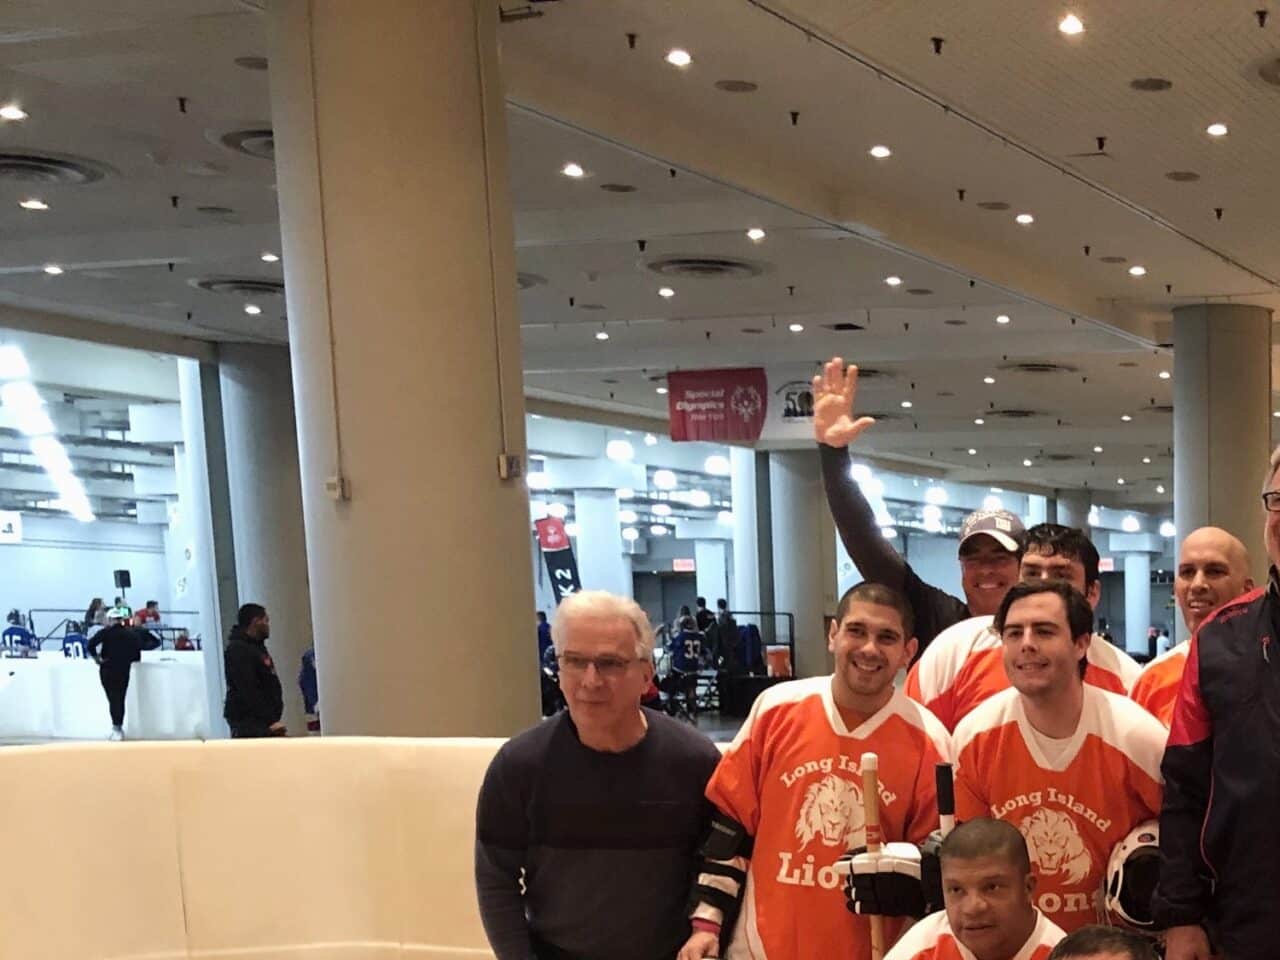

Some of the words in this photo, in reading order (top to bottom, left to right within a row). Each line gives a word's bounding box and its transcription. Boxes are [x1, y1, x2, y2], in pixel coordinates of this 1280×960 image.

[554, 567, 572, 581] 2
[64, 641, 84, 659] 30
[780, 757, 833, 788] Long
[991, 791, 1041, 819] Long
[1047, 788, 1111, 832] Island
[776, 851, 840, 890] Lio
